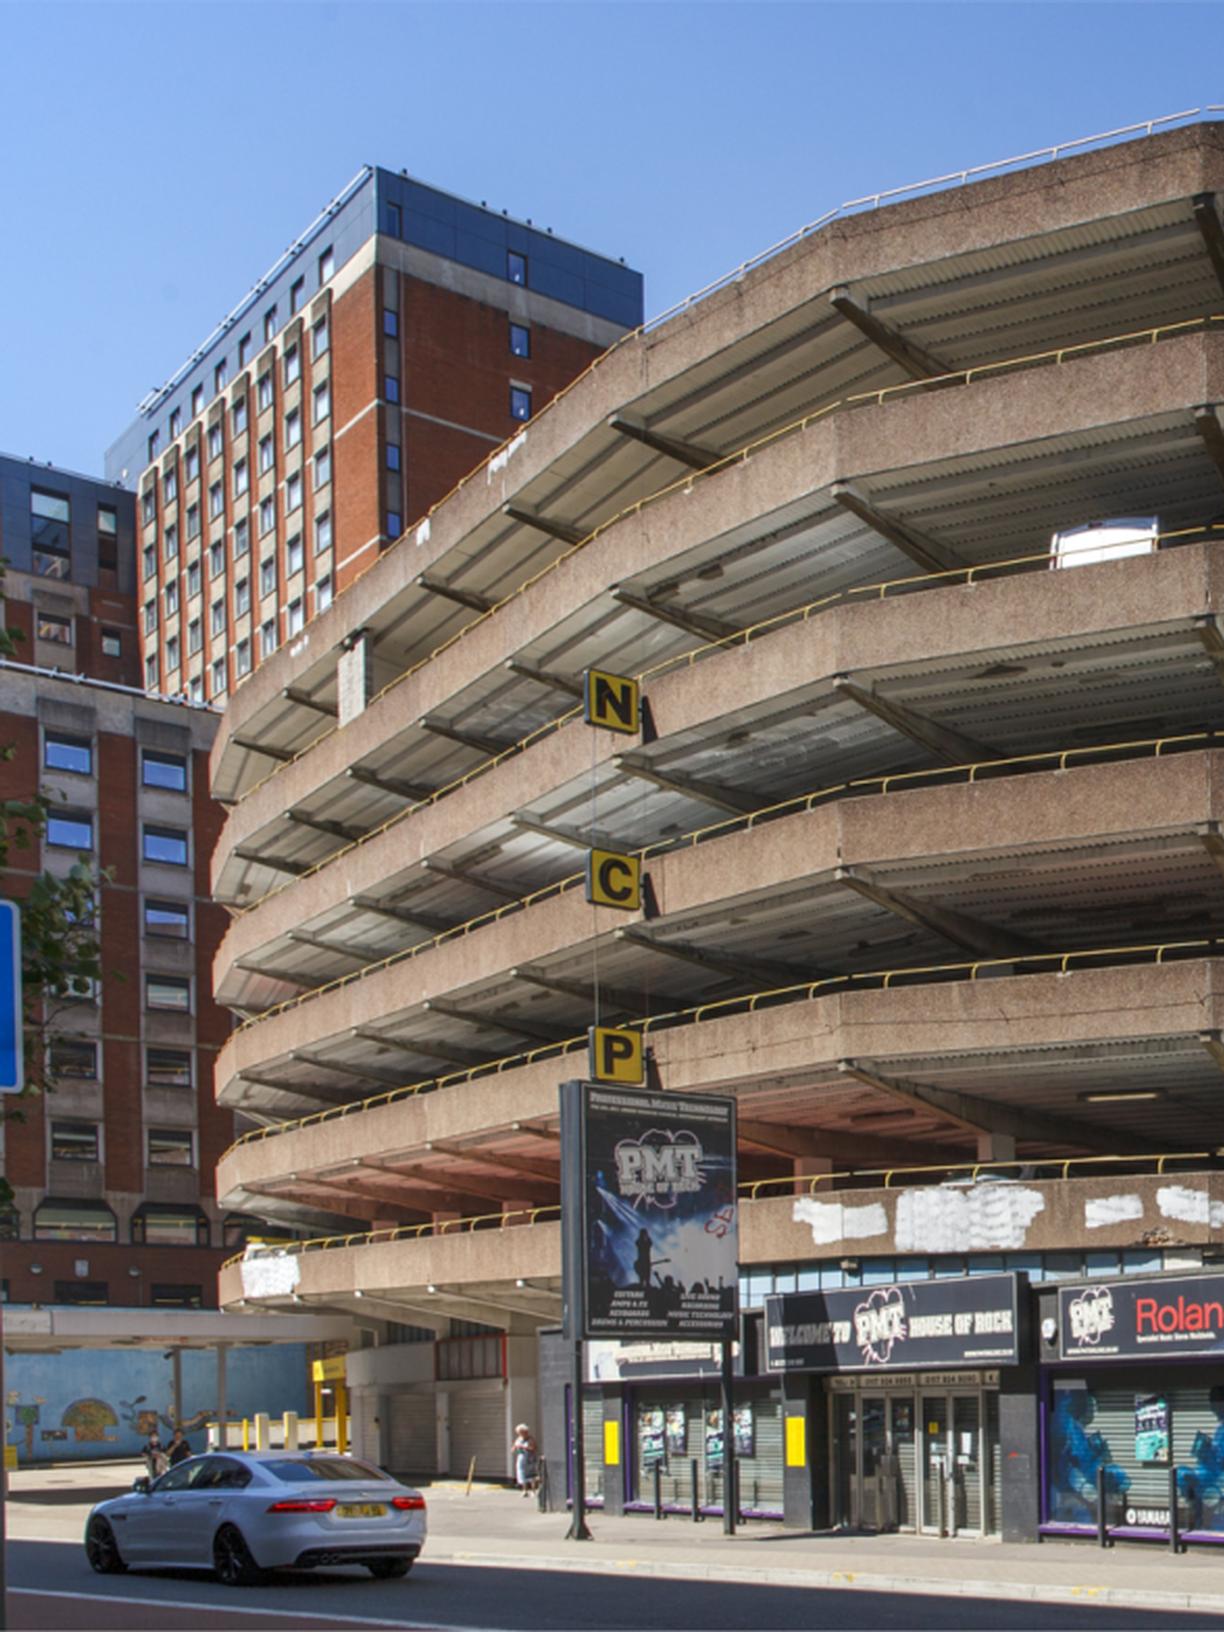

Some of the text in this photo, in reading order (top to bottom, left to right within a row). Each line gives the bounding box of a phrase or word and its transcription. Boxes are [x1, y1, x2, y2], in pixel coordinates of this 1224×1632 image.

[596, 679, 631, 726] N
[599, 858, 632, 901] C
[604, 1034, 633, 1076] P
[618, 1145, 702, 1182] PMT
[770, 1303, 1014, 1347] WELCOME TO PMT HOUSE OF ROCK
